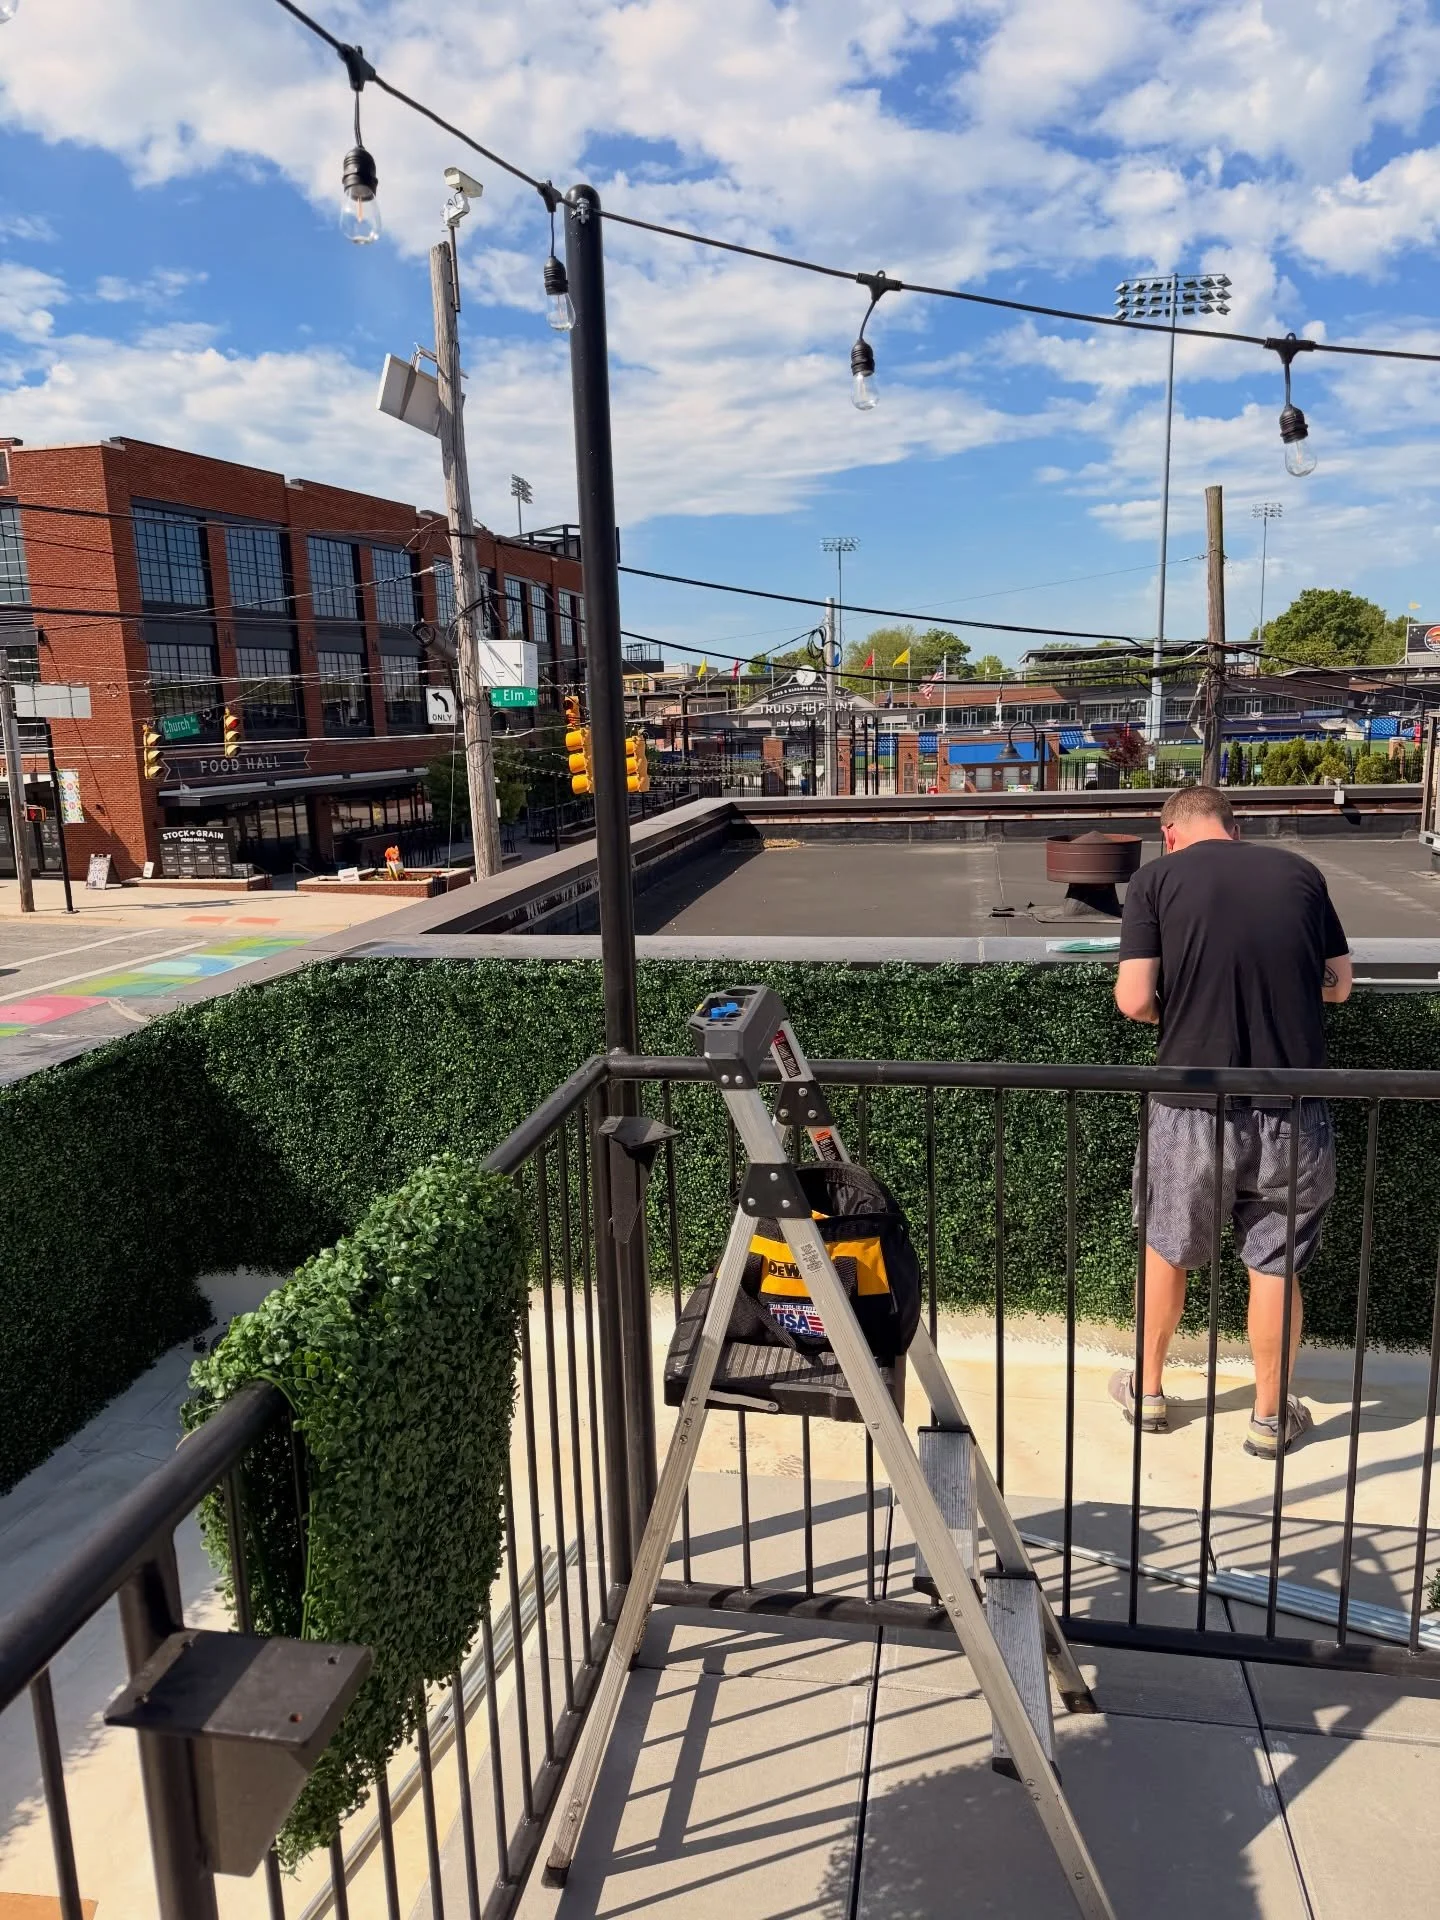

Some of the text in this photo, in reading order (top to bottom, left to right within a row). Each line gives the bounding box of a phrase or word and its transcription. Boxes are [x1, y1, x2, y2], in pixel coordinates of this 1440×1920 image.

[503, 689, 524, 701] Elm
[760, 701, 854, 714] TRUIST PINT
[432, 713, 453, 721] ONLY
[163, 717, 191, 734] Church
[200, 755, 281, 774] FOOD HALL
